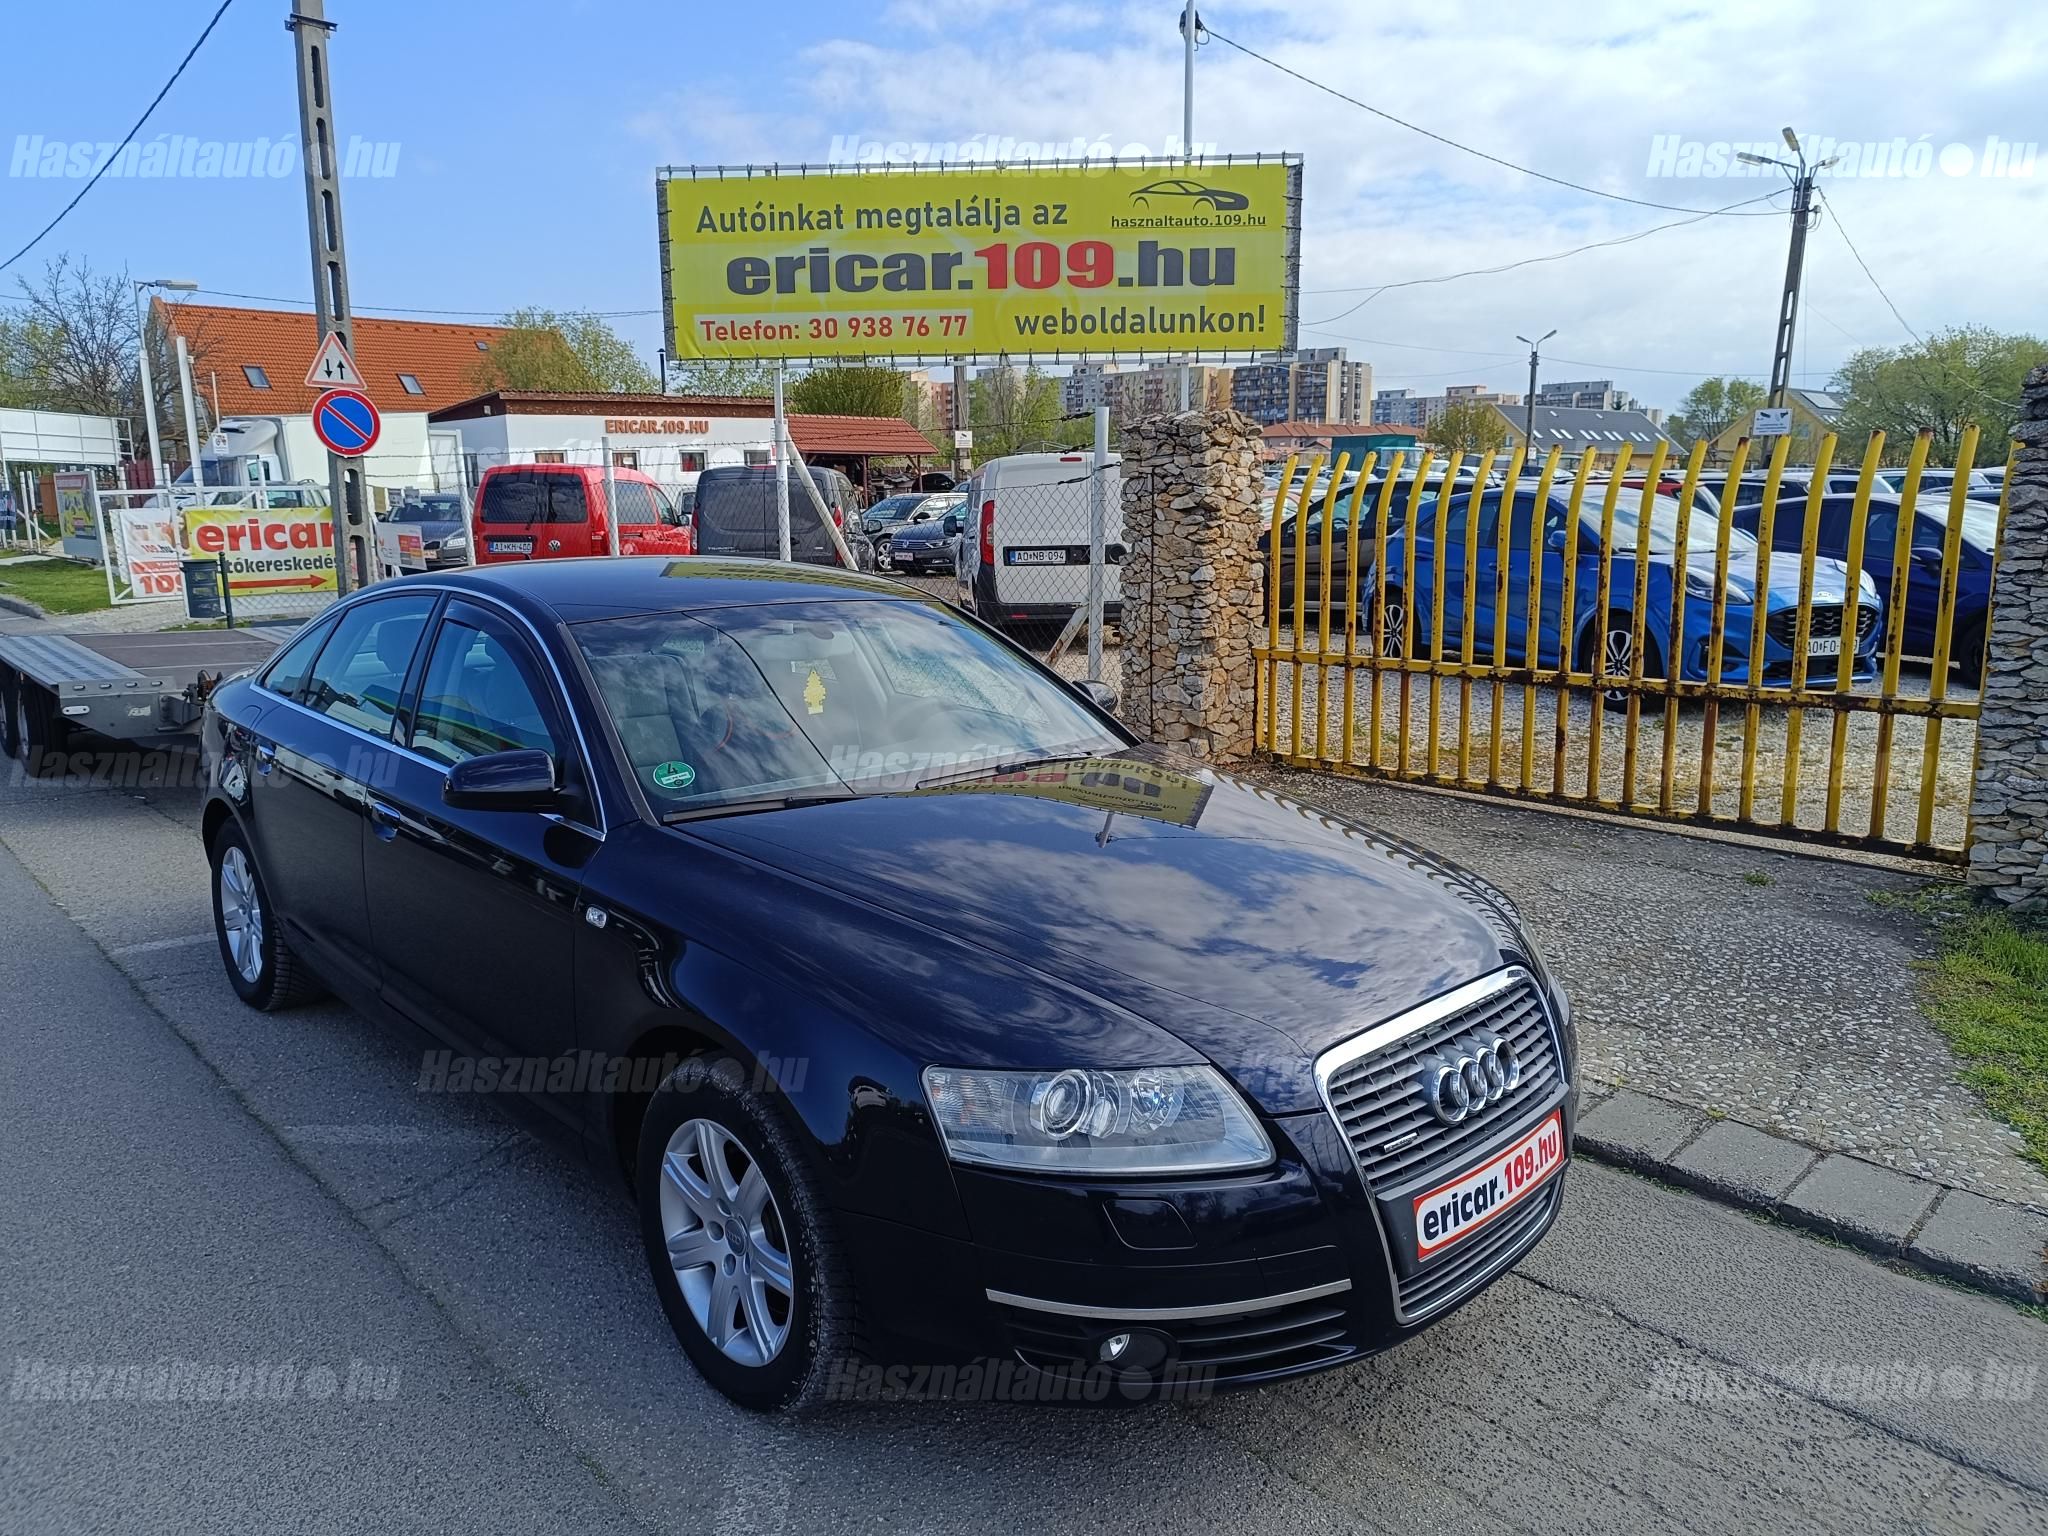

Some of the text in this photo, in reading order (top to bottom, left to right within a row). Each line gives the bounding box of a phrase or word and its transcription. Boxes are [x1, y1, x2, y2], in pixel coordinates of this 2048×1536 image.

[696, 194, 1068, 236] Autóinkat megtalálja az
[1111, 214, 1266, 228] hasznaltauto.109.hu
[726, 240, 1236, 296] ericar.109.hu
[700, 315, 967, 341] Telefon: 30 938 76 77
[1014, 304, 1265, 336] weboldalunkon!
[604, 419, 709, 434] ERICAR.109.HU
[196, 518, 335, 552] ericar
[1423, 1129, 1557, 1241] ericar.109.hu
